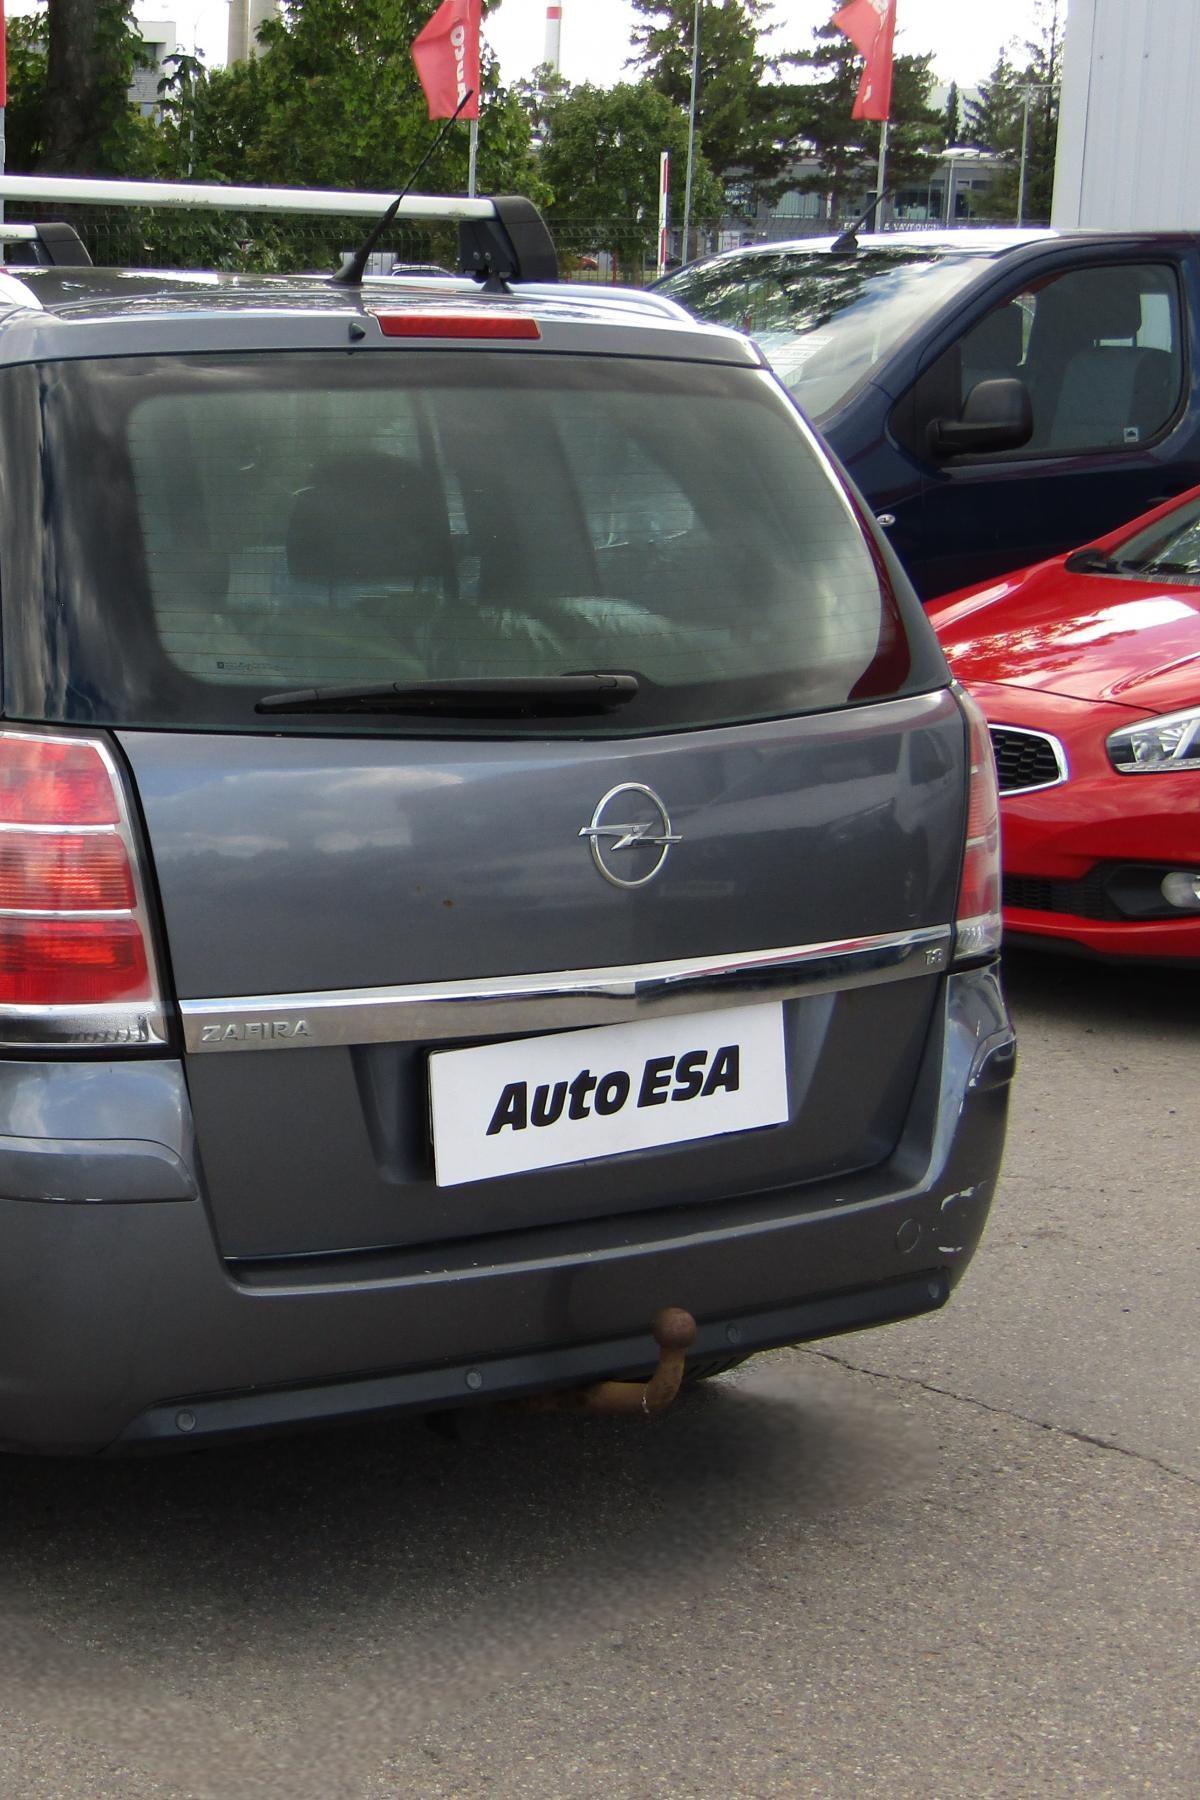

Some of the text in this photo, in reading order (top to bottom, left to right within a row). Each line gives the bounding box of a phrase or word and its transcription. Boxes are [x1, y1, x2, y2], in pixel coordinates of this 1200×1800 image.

[202, 1020, 311, 1041] ZAFIRA
[486, 1045, 739, 1136] Auto ESA
